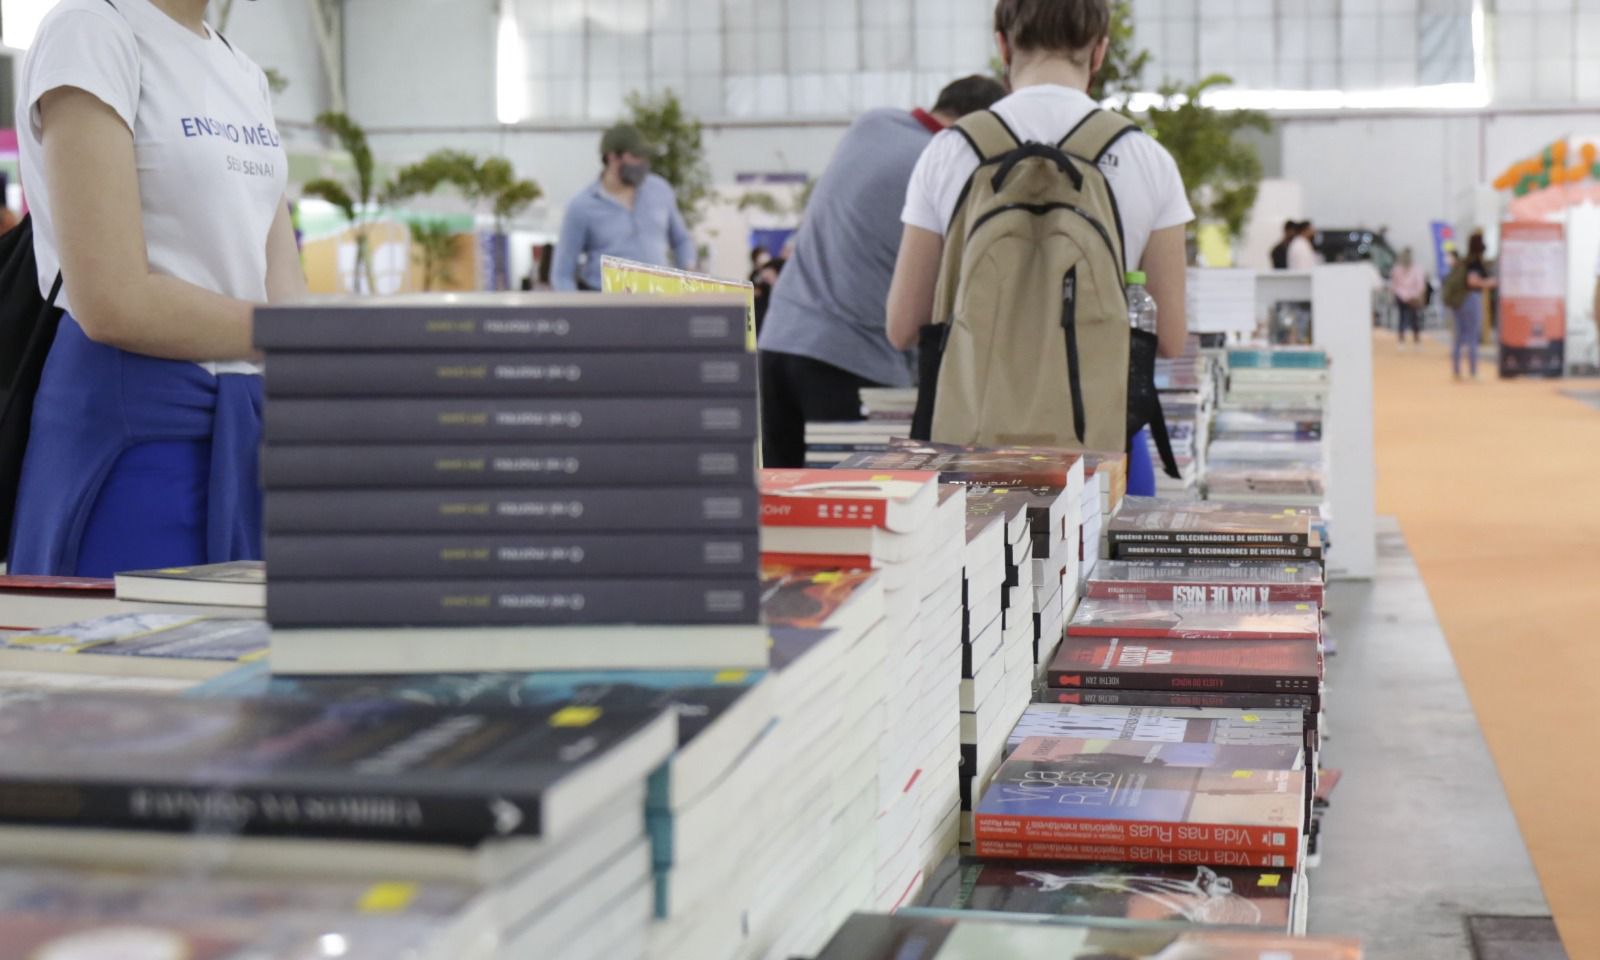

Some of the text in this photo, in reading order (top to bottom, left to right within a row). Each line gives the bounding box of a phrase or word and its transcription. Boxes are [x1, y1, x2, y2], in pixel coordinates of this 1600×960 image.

[243, 160, 274, 177] SENAI
[1175, 534, 1235, 542] COLECIONADORES
[1236, 534, 1245, 542] DE
[1247, 534, 1283, 542] HISTÓRIAS
[1188, 547, 1248, 555] COLECIONADORES
[1249, 547, 1258, 555] DE
[1260, 547, 1296, 556] HISTÓRIAS
[1173, 585, 1270, 601] A IRA DE NASI
[1085, 675, 1097, 685] ZAN
[995, 770, 1063, 802] Vida
[1058, 771, 1115, 806] Ruas
[1129, 824, 1172, 842] Ruas
[1178, 826, 1208, 841] nas
[1214, 827, 1252, 845] Vida
[1129, 846, 1251, 866] Vida nas Ruas
